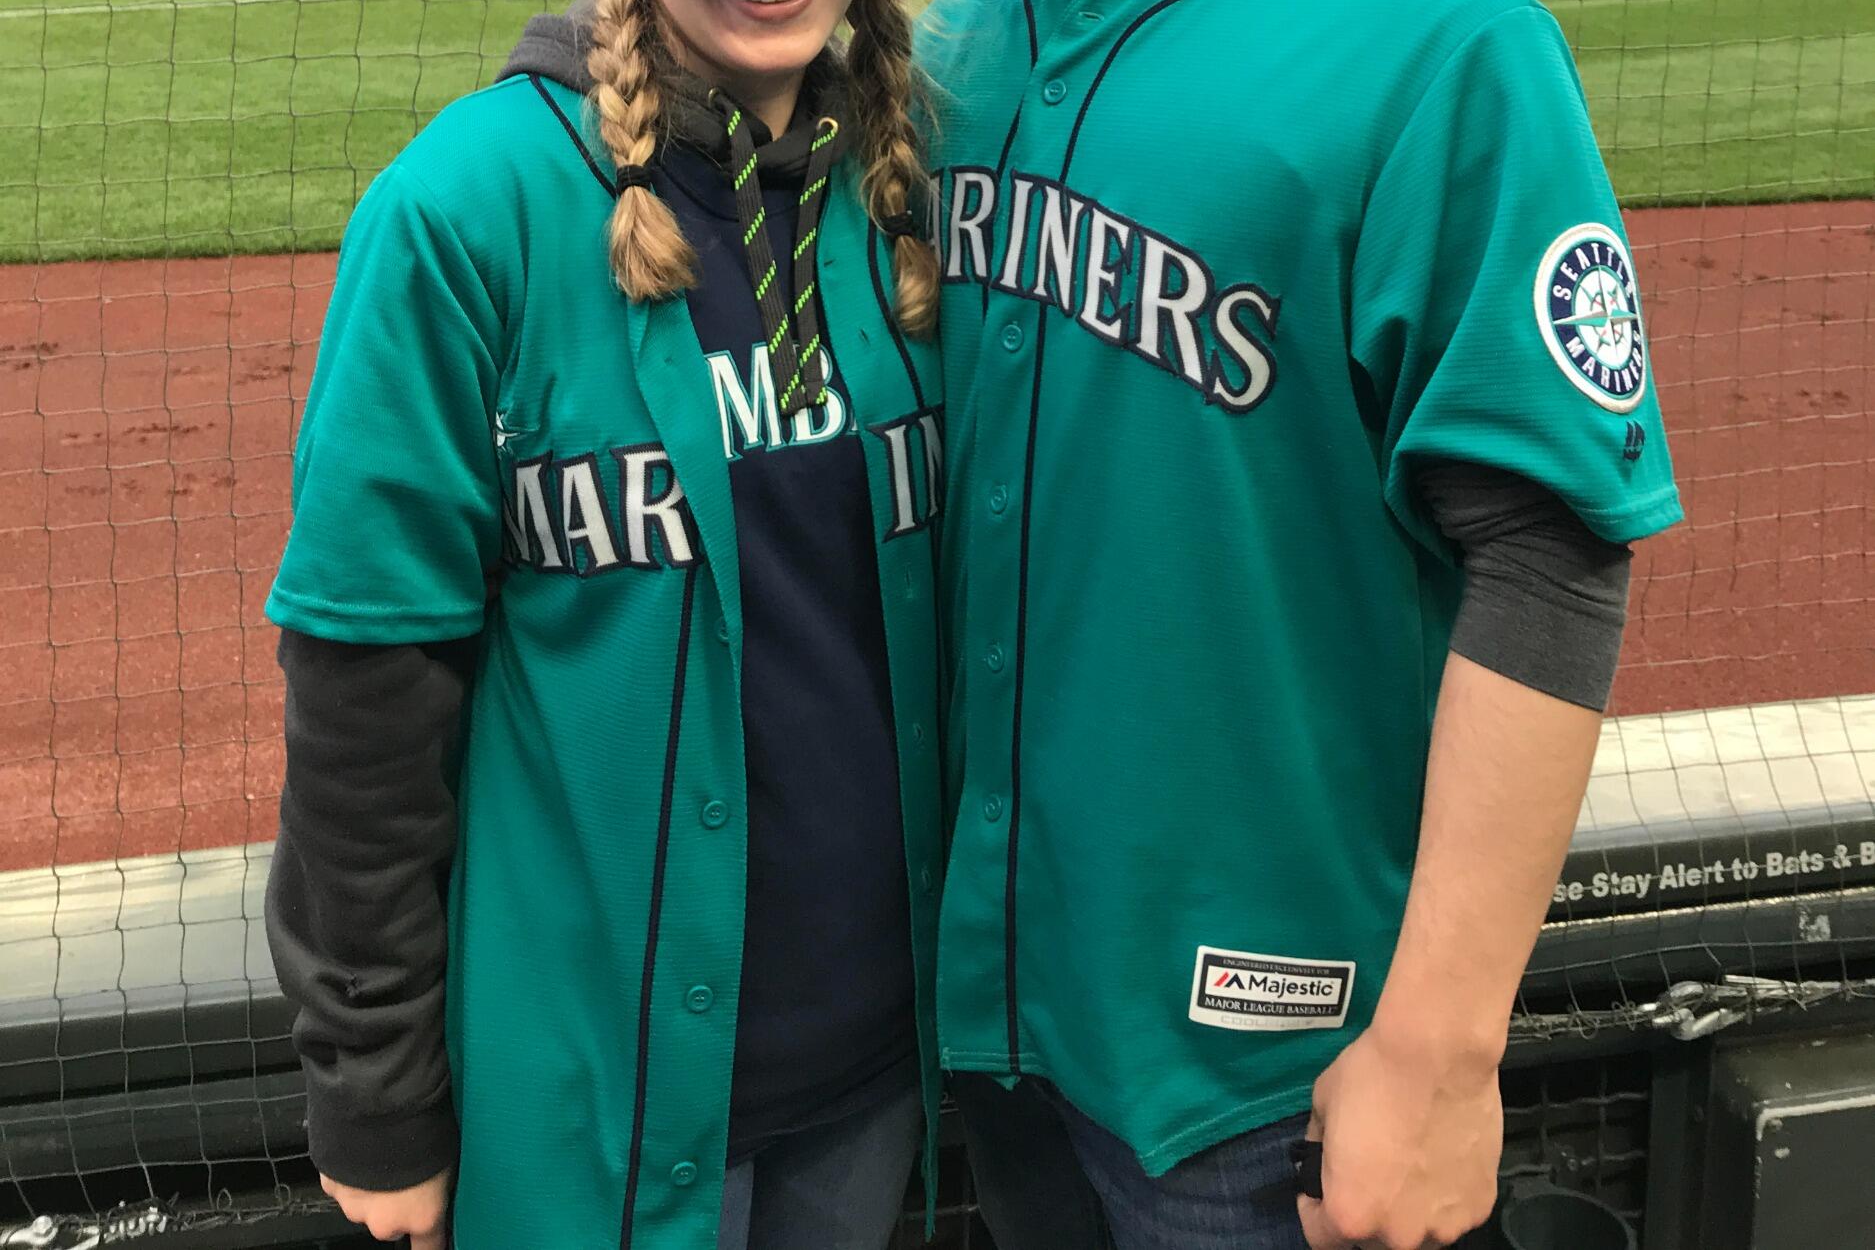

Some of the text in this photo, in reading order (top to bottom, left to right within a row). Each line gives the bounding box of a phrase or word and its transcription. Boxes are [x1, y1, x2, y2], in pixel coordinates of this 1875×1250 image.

[703, 342, 859, 462] MB
[503, 441, 704, 578] MAR
[1592, 871, 1652, 899] Stay
[1658, 860, 1725, 890] Alert
[1732, 857, 1759, 880] to
[1765, 850, 1825, 878] Bats
[1832, 844, 1852, 869] &
[1205, 997, 1334, 1015] MAJOR LEAGUE BASEBALL
[1248, 974, 1334, 998] Majestic
